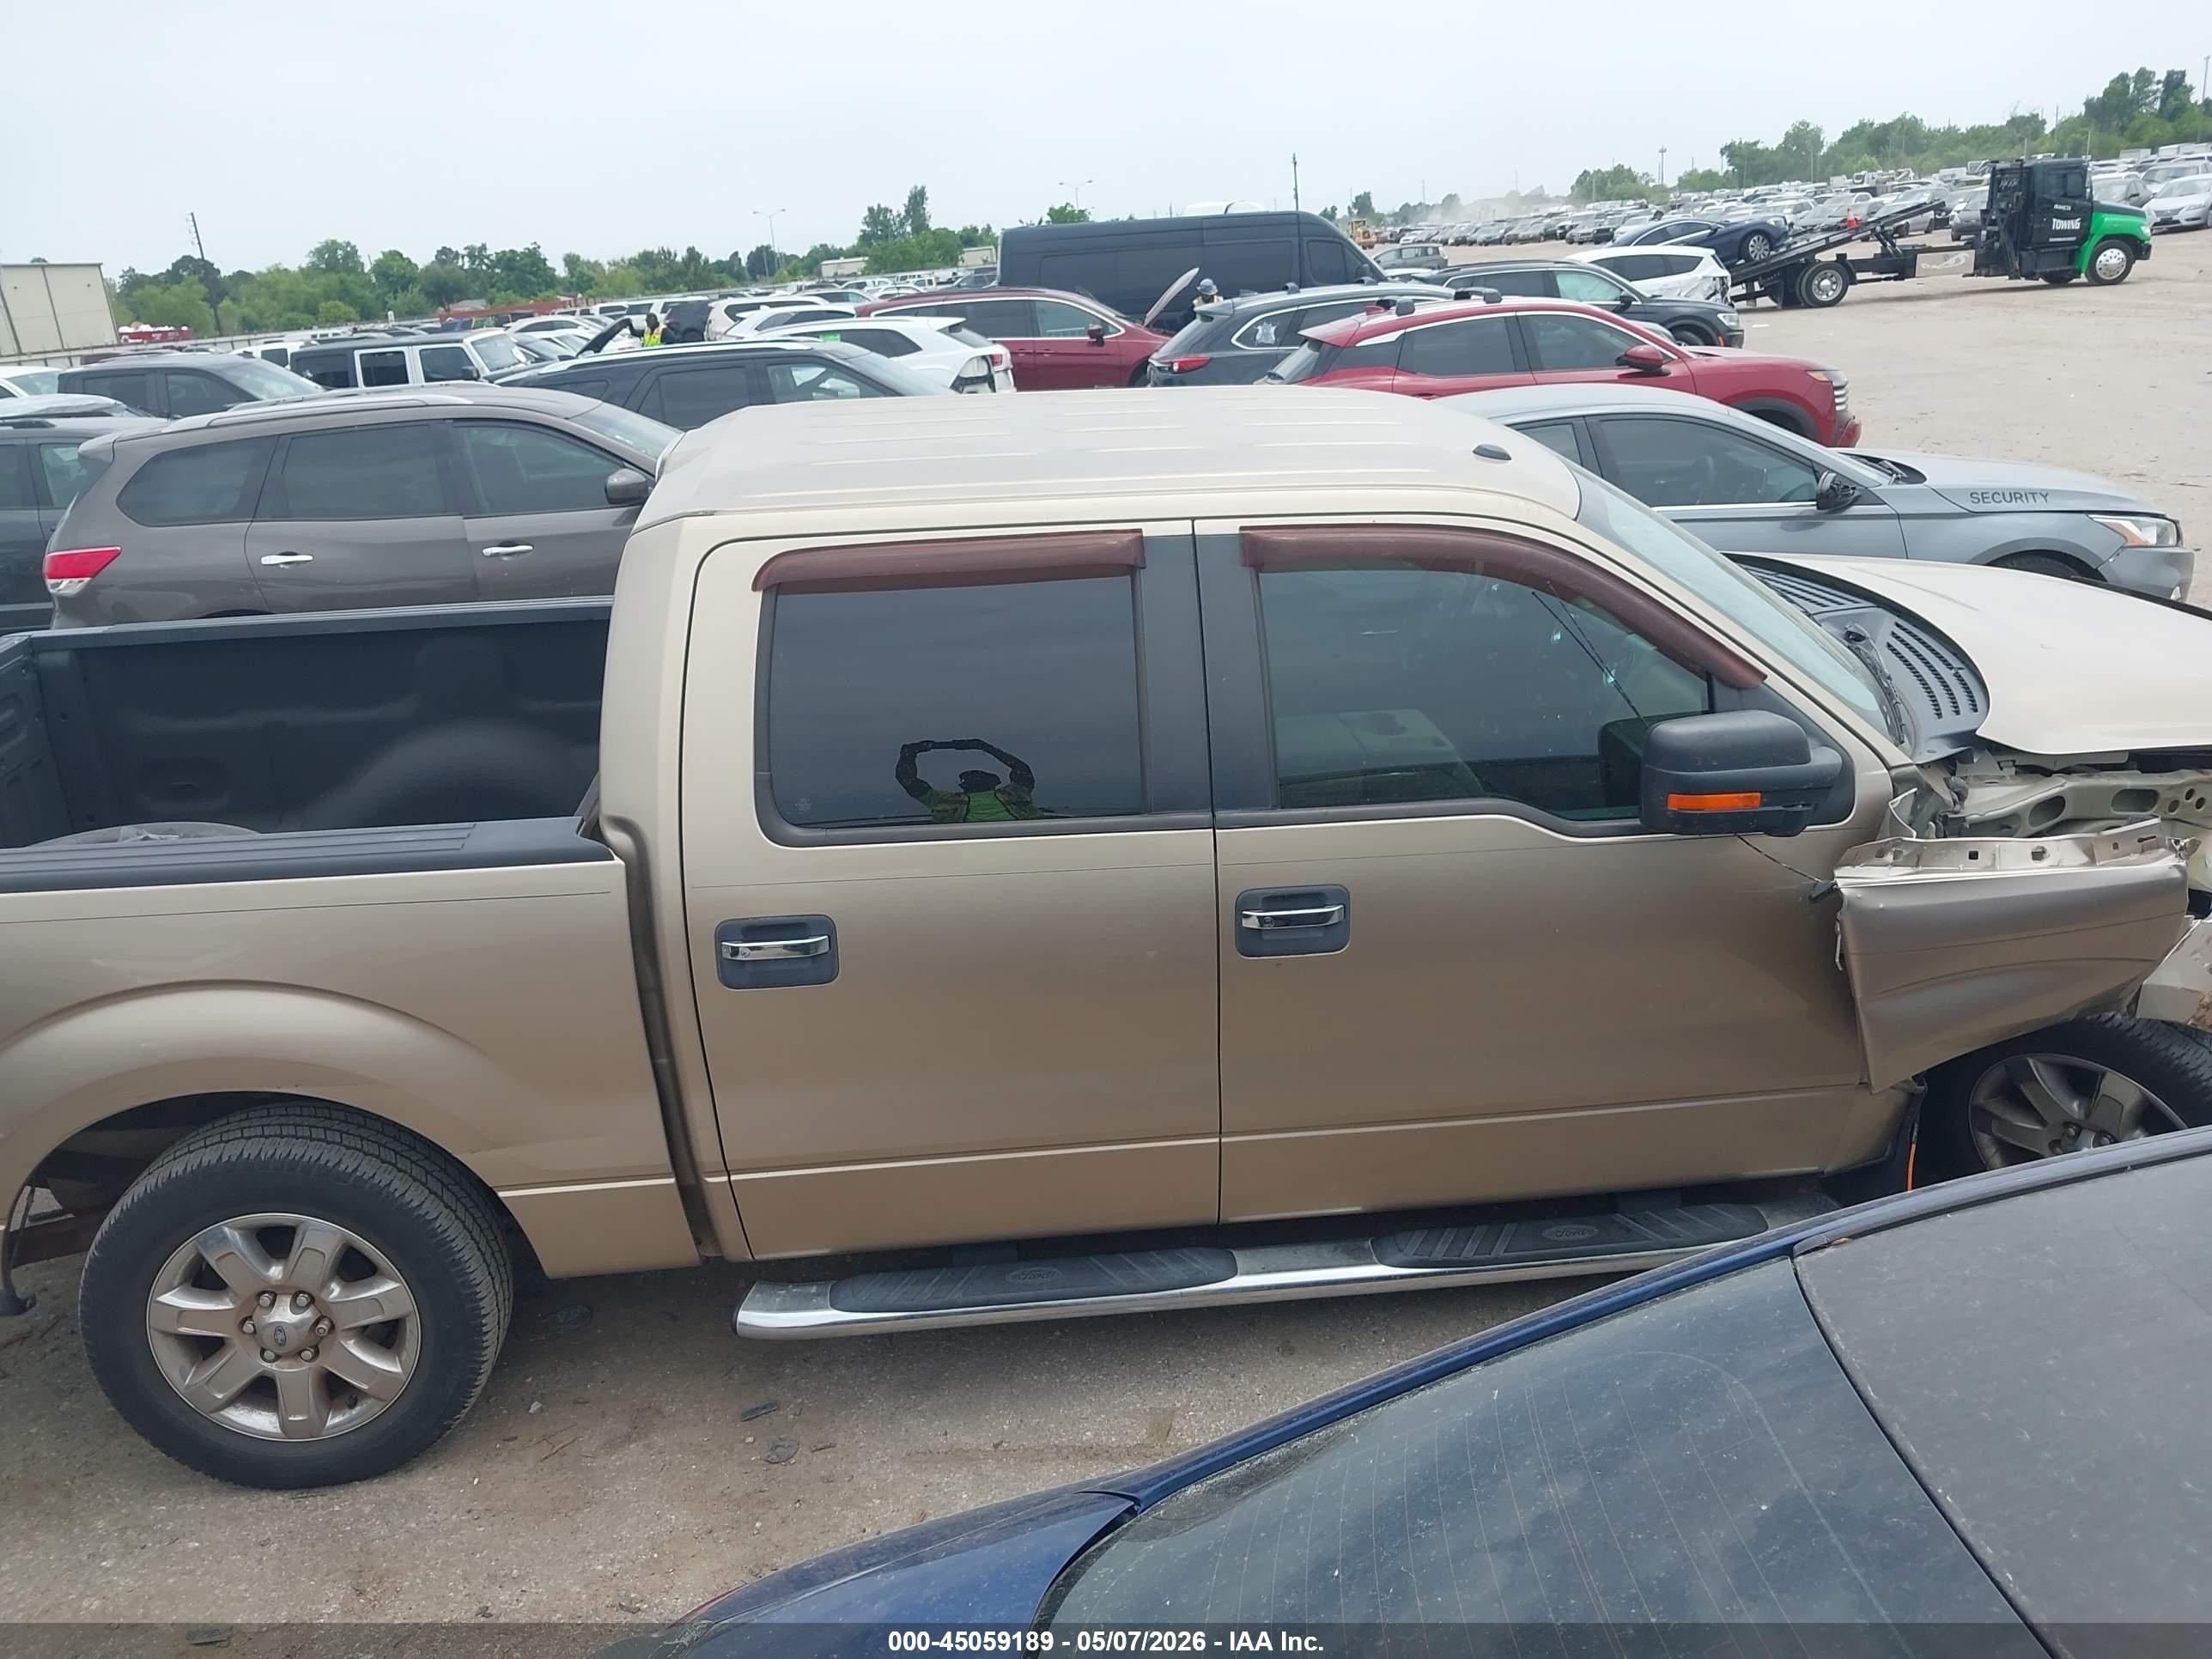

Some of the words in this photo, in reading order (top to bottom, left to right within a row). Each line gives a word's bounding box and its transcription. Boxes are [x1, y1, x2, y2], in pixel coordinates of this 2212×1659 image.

[2051, 216, 2082, 230] TOWING
[1969, 491, 2050, 505] SECURITY
[1553, 1227, 1588, 1239] Ford
[1017, 1268, 1053, 1281] Ford
